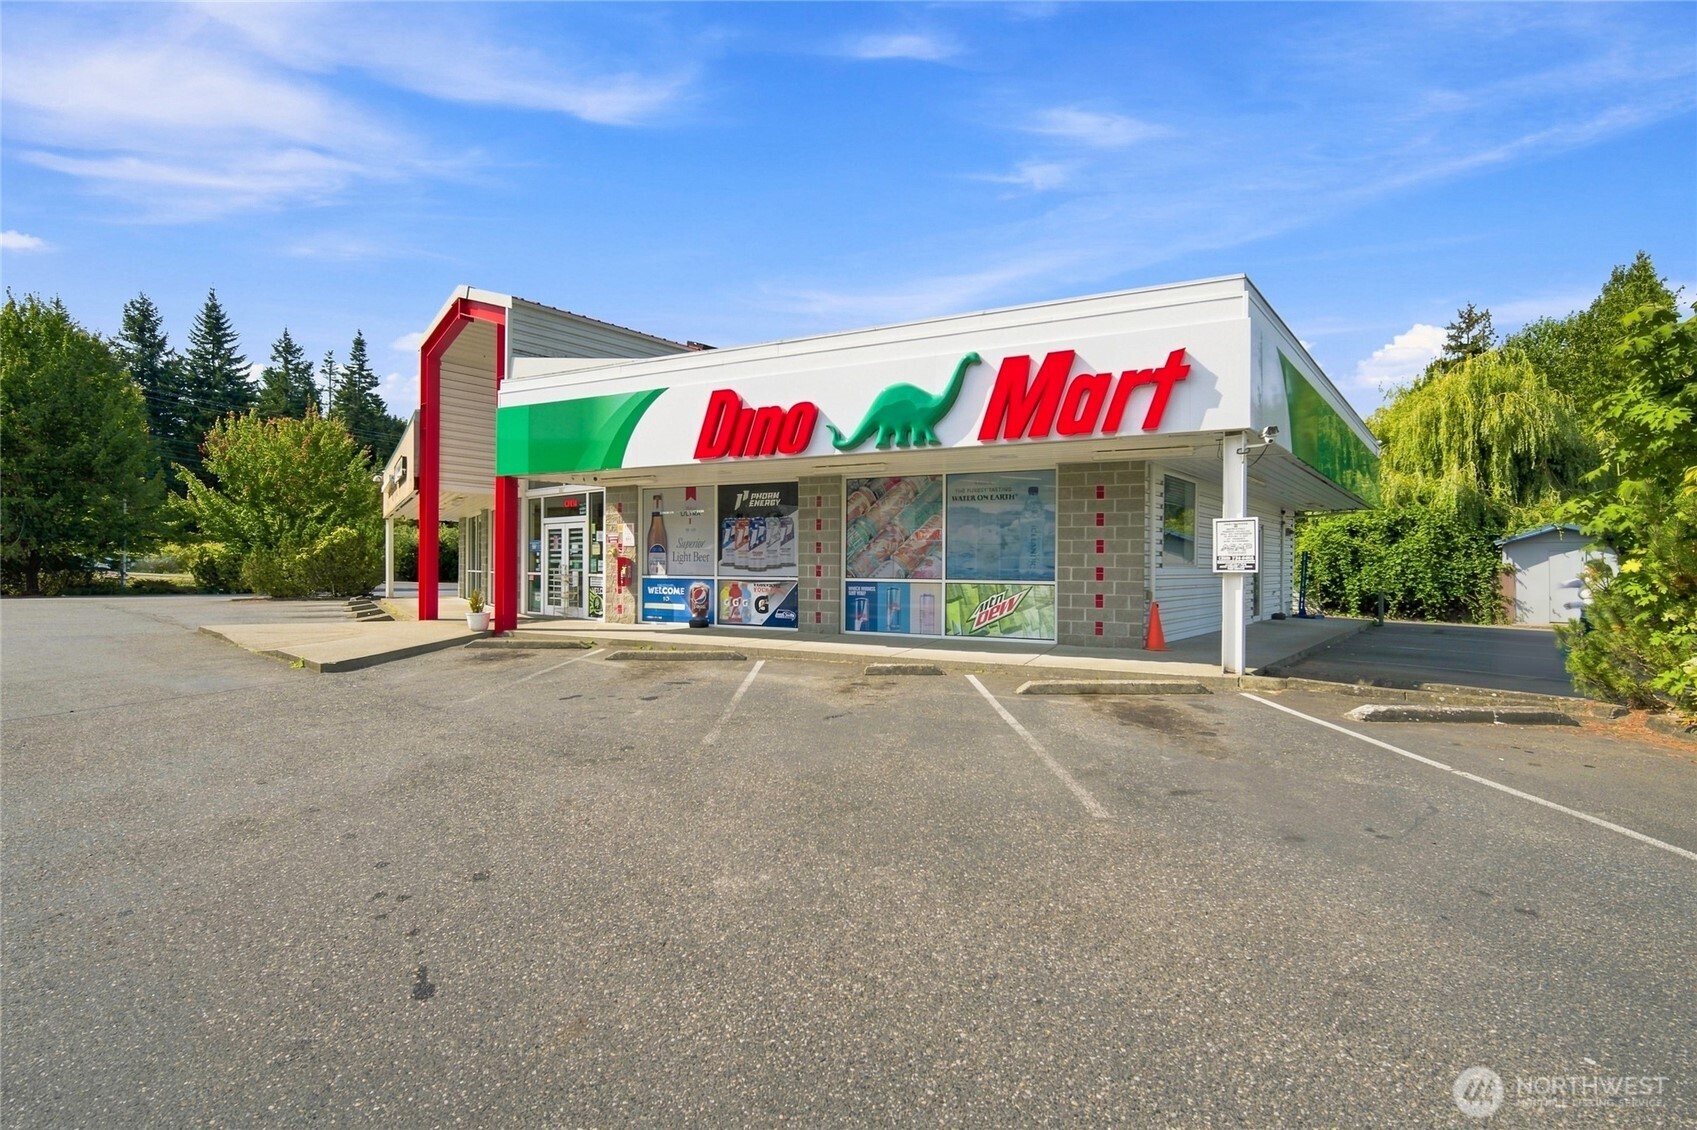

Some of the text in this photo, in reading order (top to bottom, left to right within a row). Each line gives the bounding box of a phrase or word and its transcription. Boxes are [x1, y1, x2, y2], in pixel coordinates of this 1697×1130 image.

[694, 347, 1191, 460] Dino Mart
[750, 491, 780, 500] PHORM
[952, 494, 976, 502] WATER
[749, 499, 781, 507] ENERGY
[676, 537, 706, 550] Superior
[672, 551, 692, 565] Light
[693, 551, 710, 562] Beer
[647, 586, 685, 595] WELCOME
[754, 595, 769, 614] G
